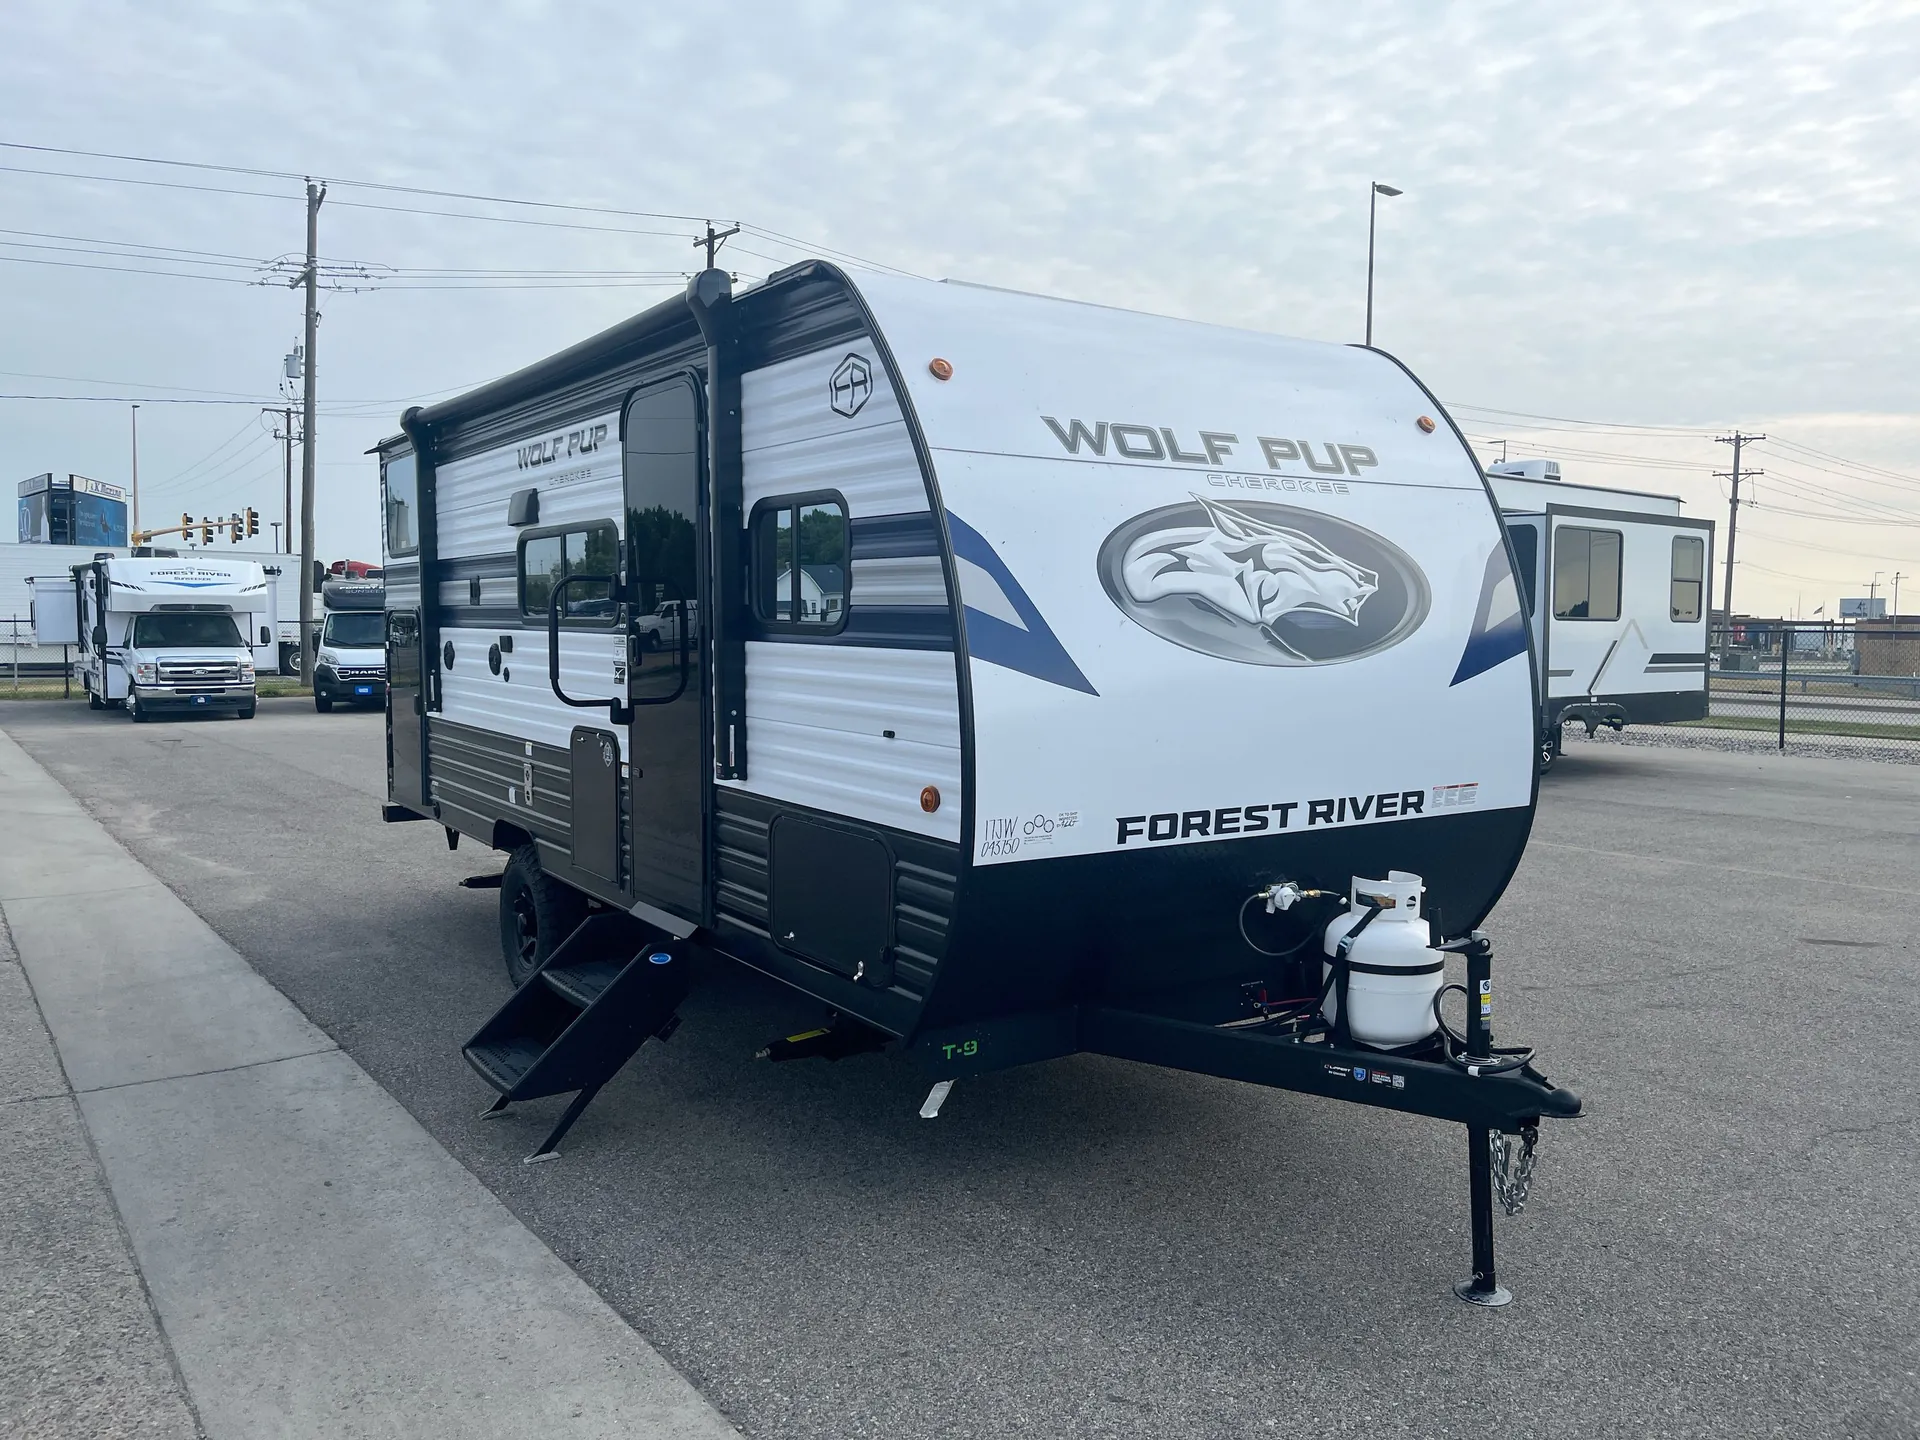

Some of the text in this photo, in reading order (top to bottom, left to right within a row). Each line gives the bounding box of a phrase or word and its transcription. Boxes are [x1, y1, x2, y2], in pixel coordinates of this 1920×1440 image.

[517, 424, 608, 471] WOLF PUP
[1040, 415, 1379, 476] WOLF PUP
[549, 469, 592, 486] CHEROKEE
[1206, 473, 1351, 495] CHEROKEE
[1116, 801, 1298, 845] FOREST
[1307, 790, 1425, 826] RIVER
[942, 1040, 978, 1060] T-9
